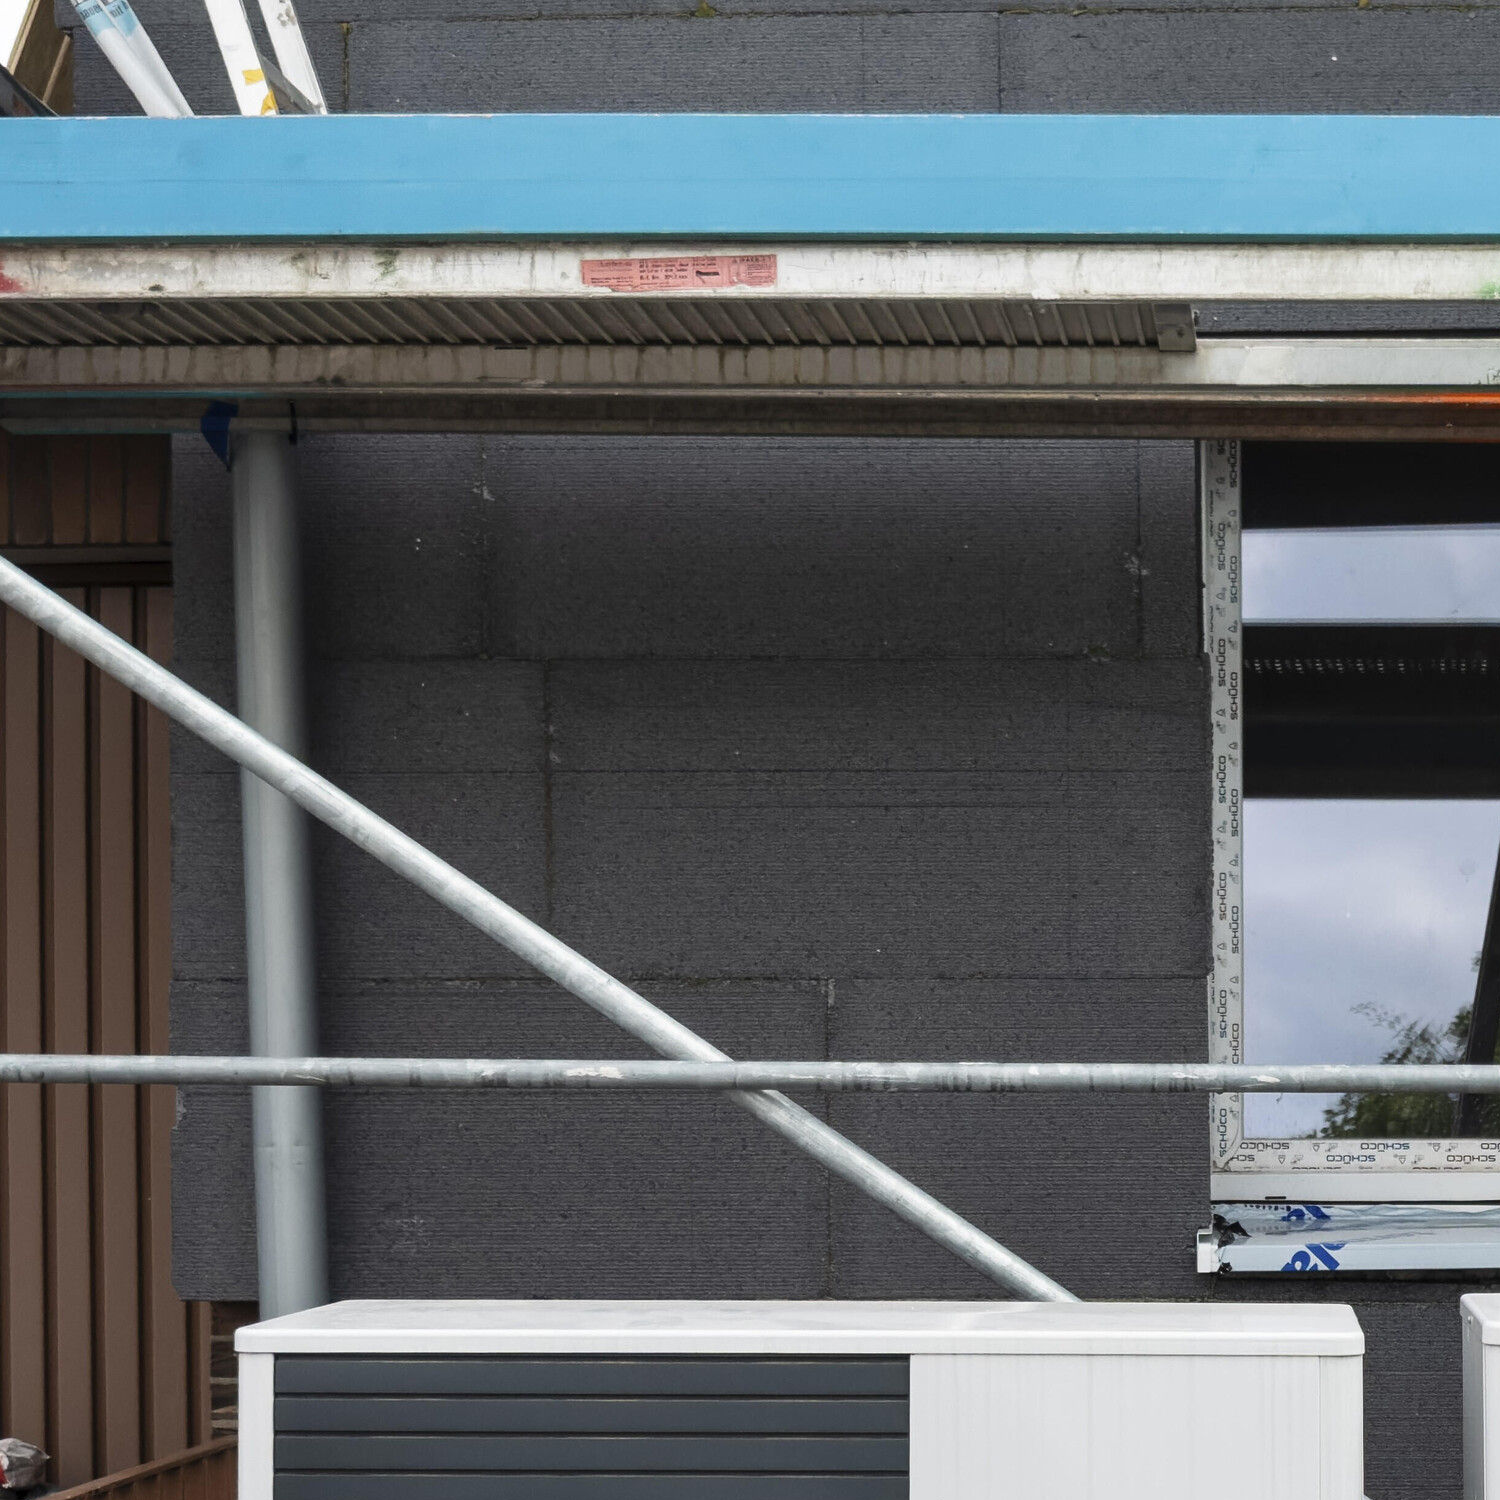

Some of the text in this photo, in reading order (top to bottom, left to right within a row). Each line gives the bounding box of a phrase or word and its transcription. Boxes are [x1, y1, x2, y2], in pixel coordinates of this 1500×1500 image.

[1214, 523, 1226, 571] SCHÜCO
[1227, 555, 1238, 603] SCHÜCO
[1215, 638, 1226, 687] SCHÜCO
[1228, 672, 1240, 720] SCHÜCO
[1217, 755, 1227, 803] SCHÜCO
[1229, 788, 1239, 837] SCHÜCO
[1217, 872, 1227, 921] SCHÜCO
[1229, 905, 1239, 954] SCHÜCO
[1217, 989, 1228, 1038] SCHÜCO
[1230, 1023, 1240, 1064] CHÜCO
[1218, 1108, 1228, 1157] SCHÜCO
[1240, 1142, 1290, 1152] SCHÜCO
[1360, 1142, 1410, 1152] SCHÜCO
[1326, 1154, 1376, 1165] SCHÜCO
[1446, 1154, 1496, 1165] SCHÜCO
